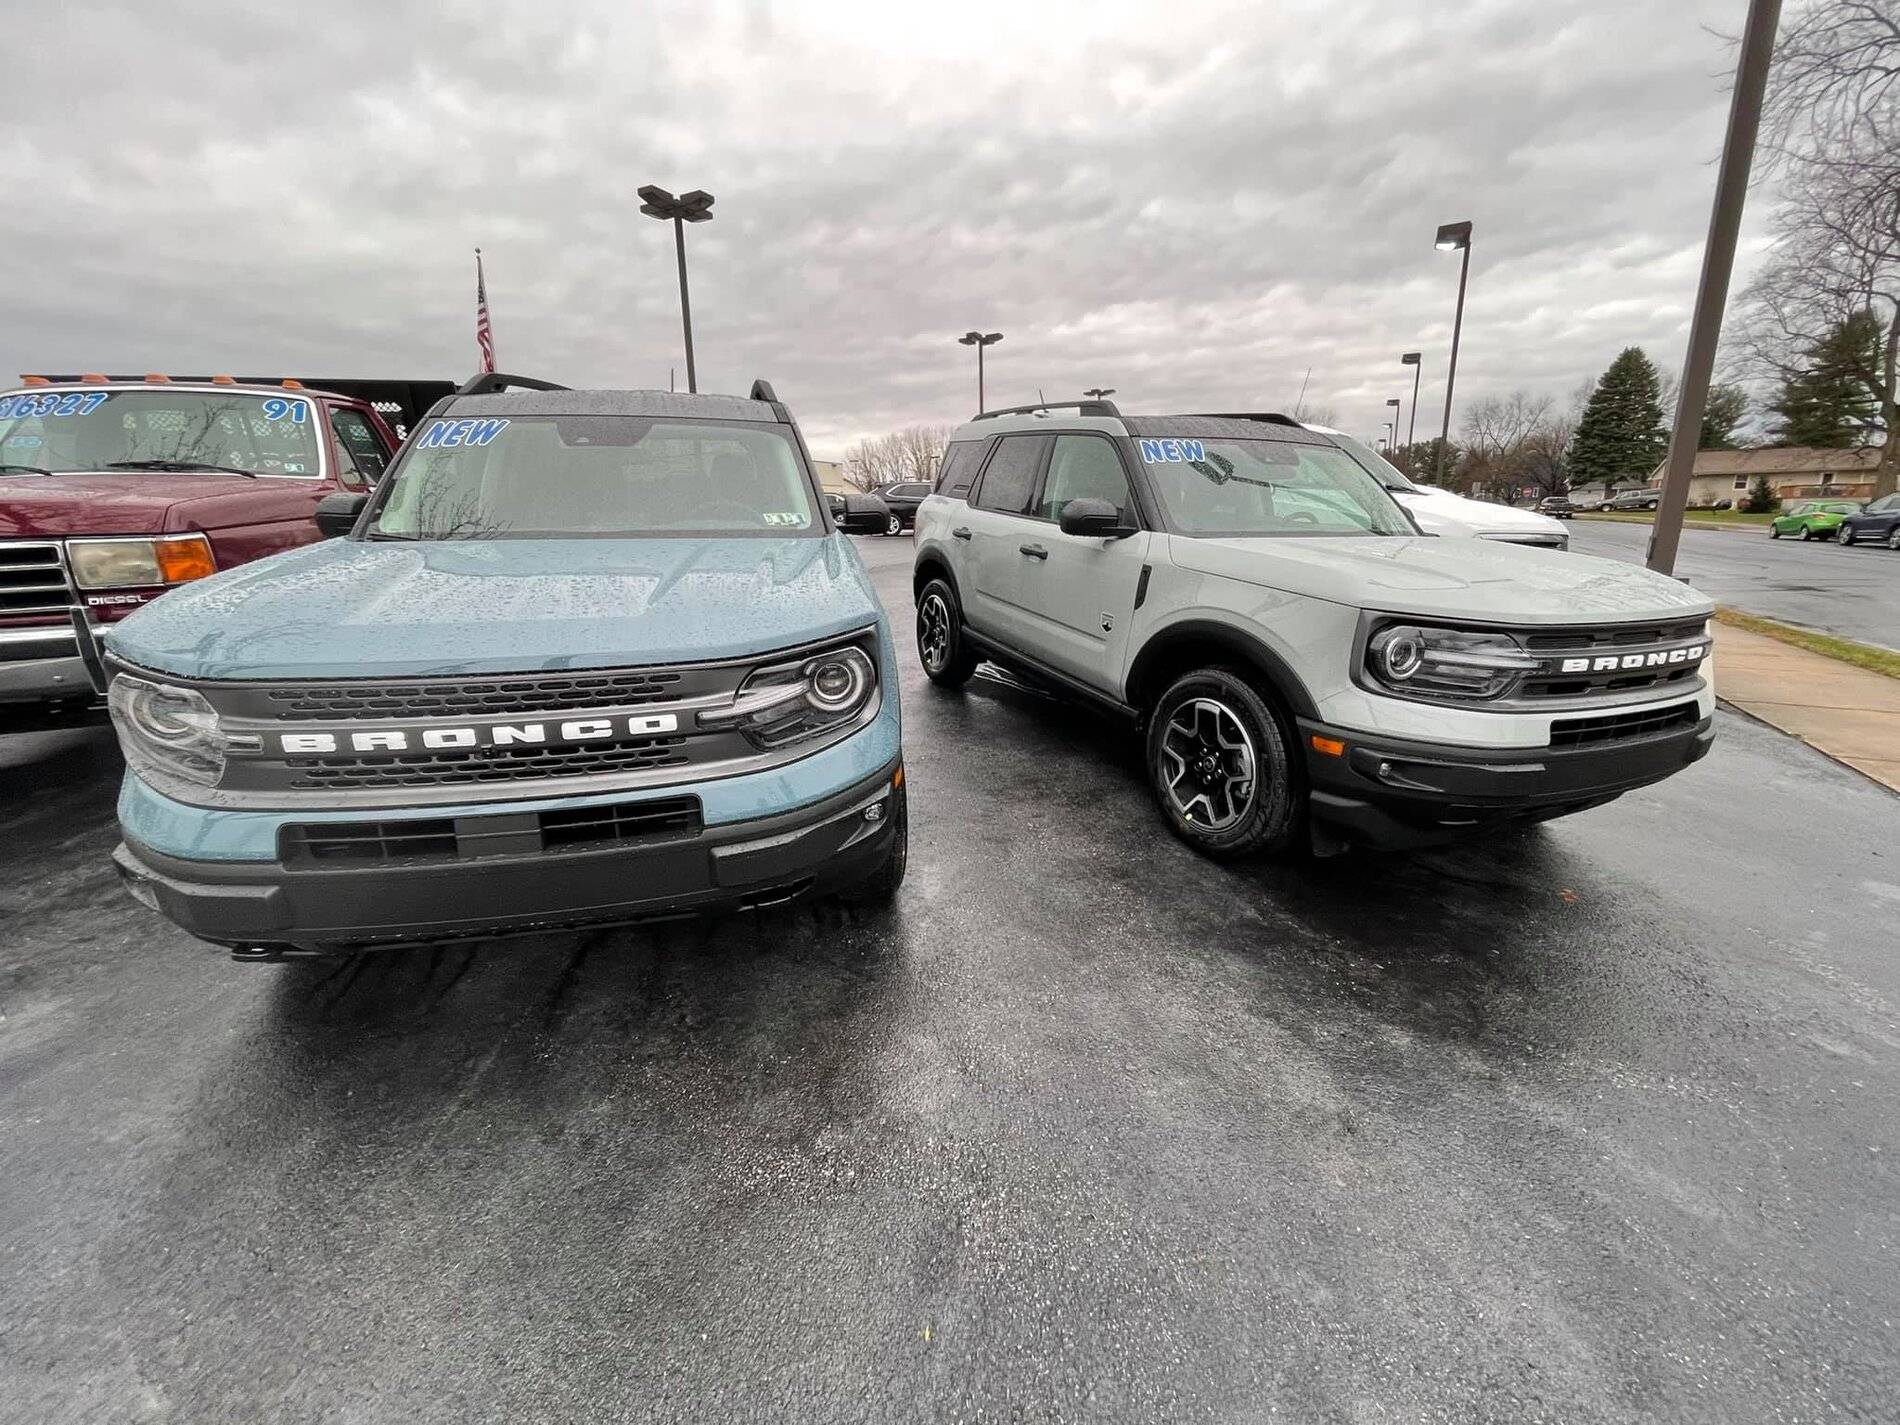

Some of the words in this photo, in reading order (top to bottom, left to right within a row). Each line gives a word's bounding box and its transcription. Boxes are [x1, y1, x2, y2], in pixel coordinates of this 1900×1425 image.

[262, 399, 307, 423] 91
[416, 419, 511, 449] NEW
[1140, 439, 1206, 464] NEW
[87, 595, 148, 606] DIESEL
[1561, 646, 1704, 673] BRONCO
[281, 713, 679, 753] BRONCO
